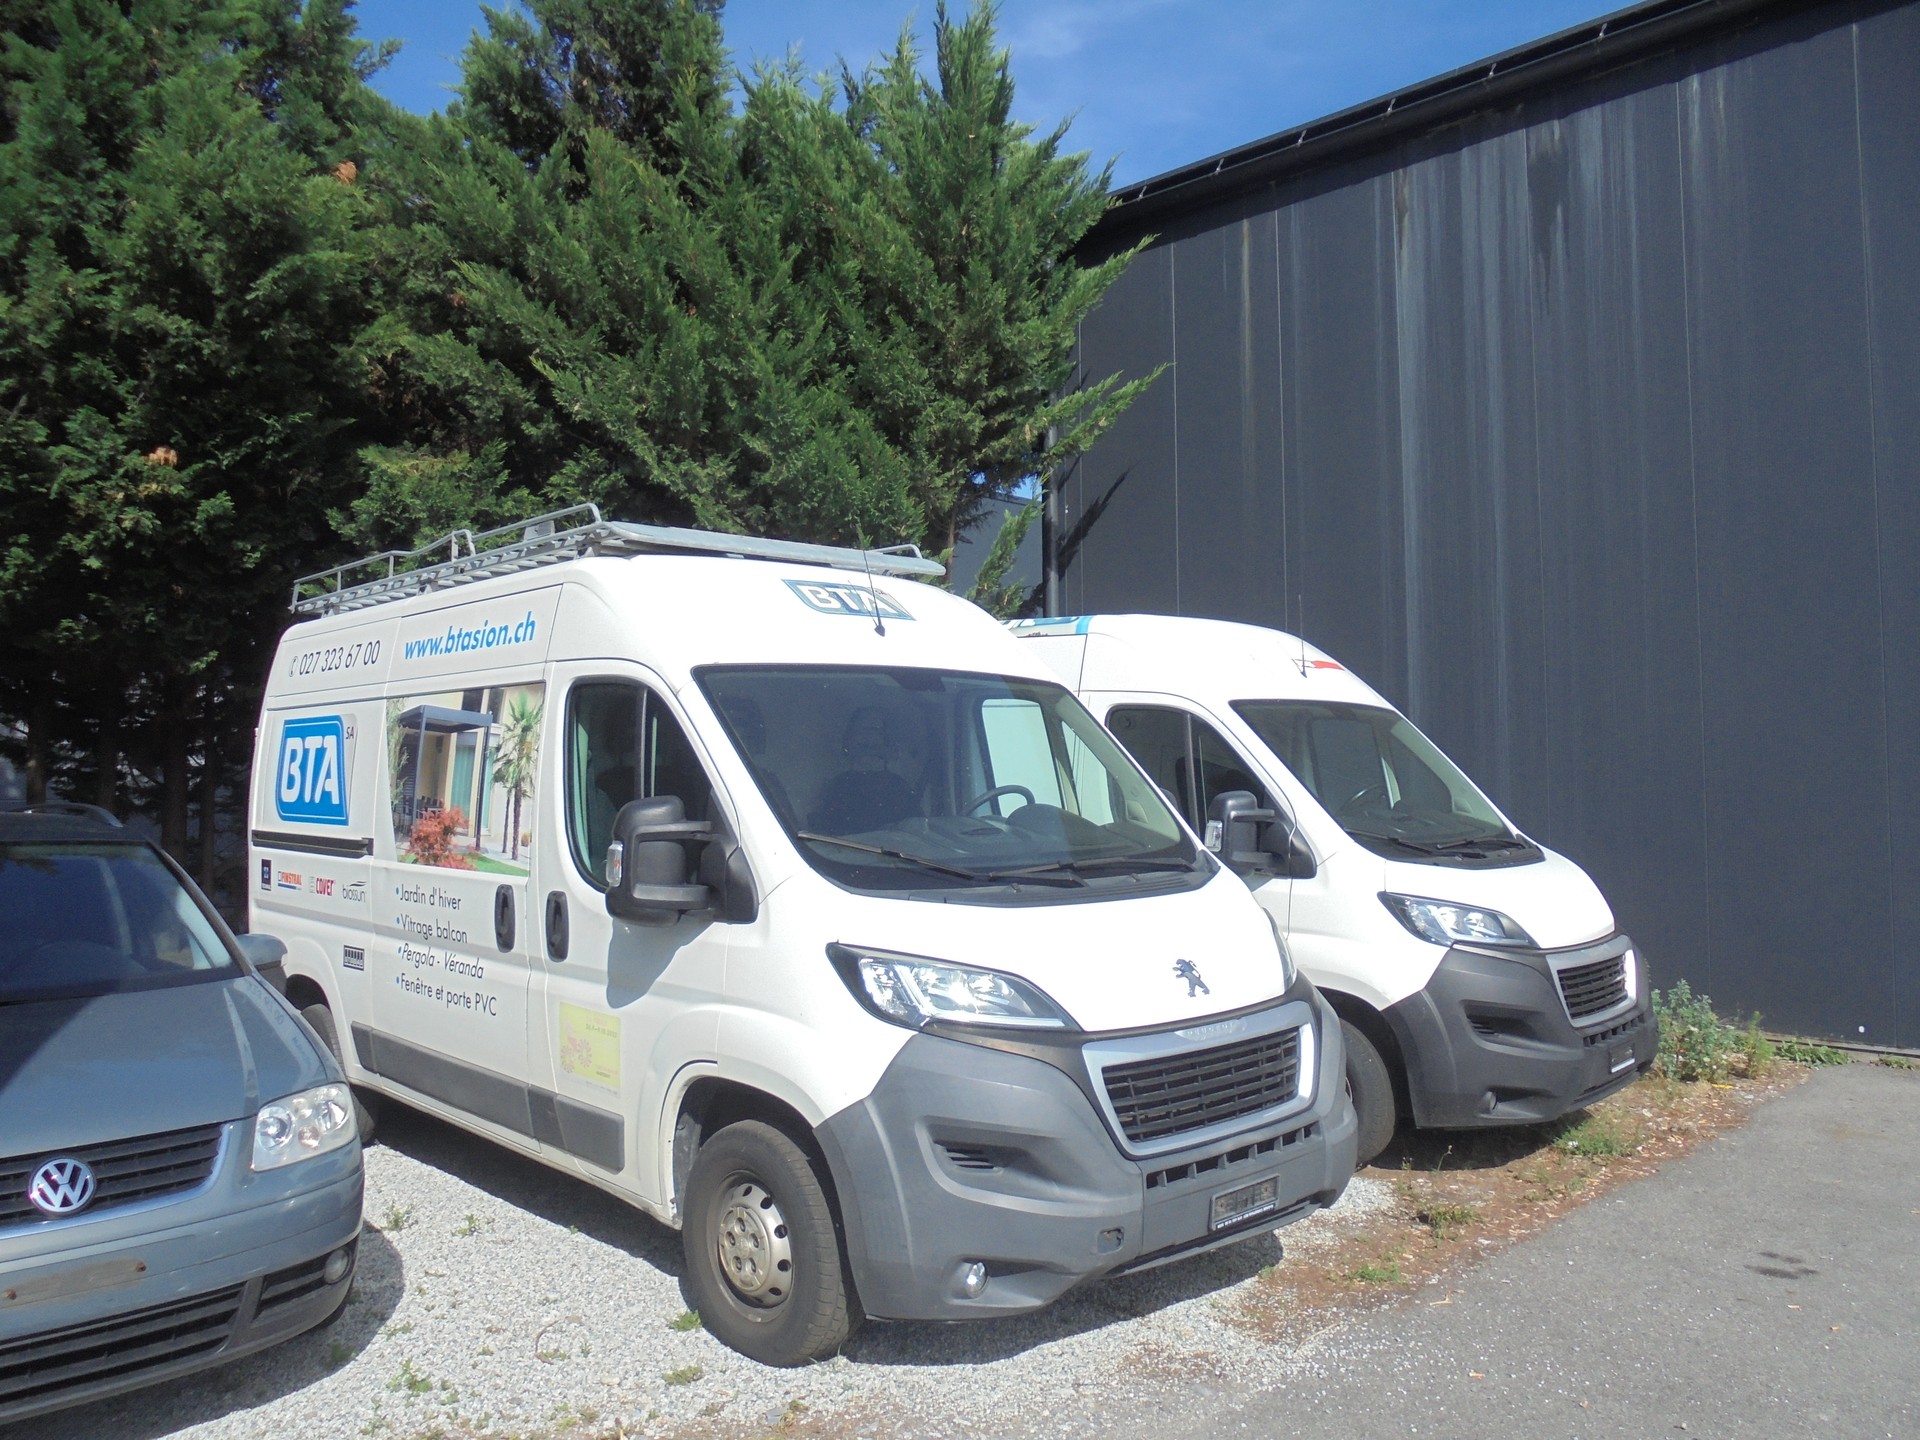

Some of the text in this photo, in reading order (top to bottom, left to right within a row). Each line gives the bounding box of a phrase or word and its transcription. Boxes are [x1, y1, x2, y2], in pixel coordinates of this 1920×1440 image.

[797, 584, 898, 613] BTA
[405, 611, 536, 660] www.btasion.ch
[299, 640, 380, 675] 027 323 67 00
[345, 726, 355, 739] SA
[280, 734, 340, 805] BTA
[342, 883, 366, 903] biossun
[400, 883, 426, 904] Jardin
[400, 913, 468, 943] Vitrage balcon
[401, 942, 435, 969] Pergola
[444, 951, 484, 979] Véranda
[401, 972, 497, 1016] Fenêtre et porte PVC
